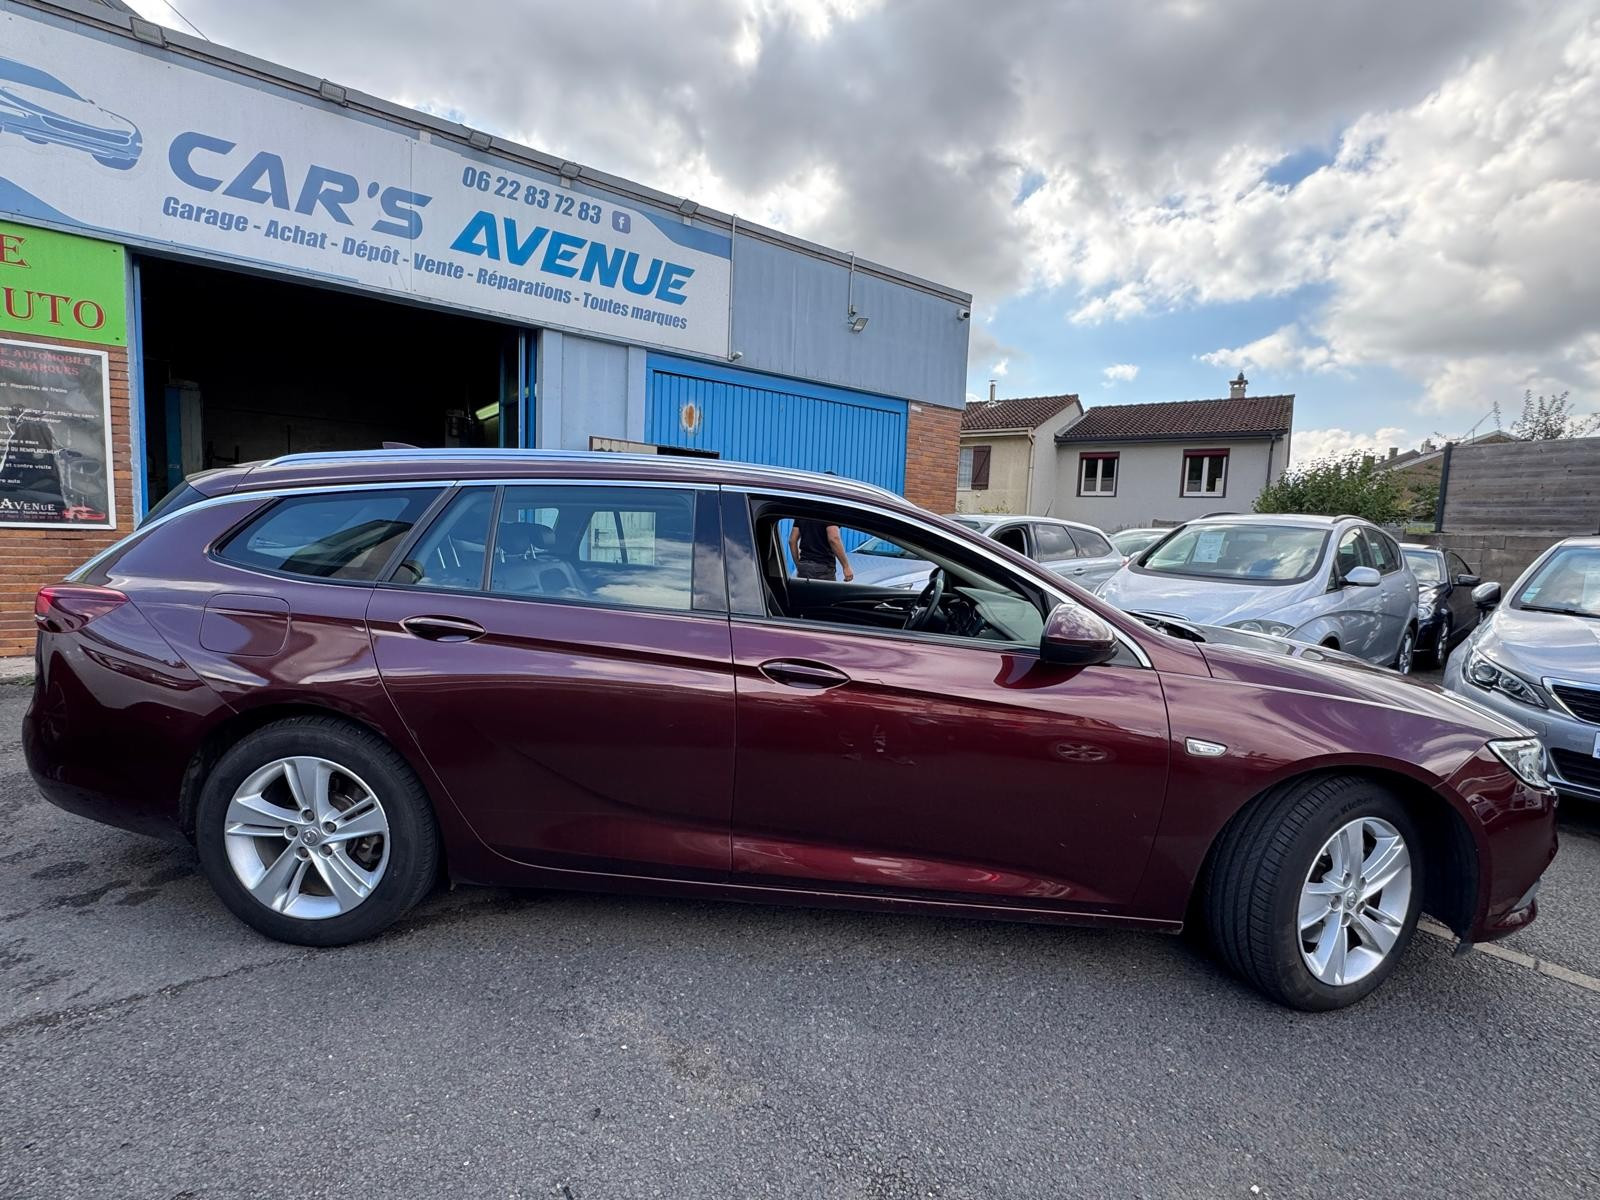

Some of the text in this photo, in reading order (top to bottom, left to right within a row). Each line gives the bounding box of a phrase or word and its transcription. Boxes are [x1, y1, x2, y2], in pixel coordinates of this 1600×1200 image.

[168, 131, 433, 240] CAR'S
[462, 166, 602, 225] 06 22 83 72 83
[162, 196, 688, 330] Garage Achat Dépôt Vente Réparations Toutes marques
[450, 210, 695, 305] AVENUE
[14, 349, 92, 367] AUTOMOBILE
